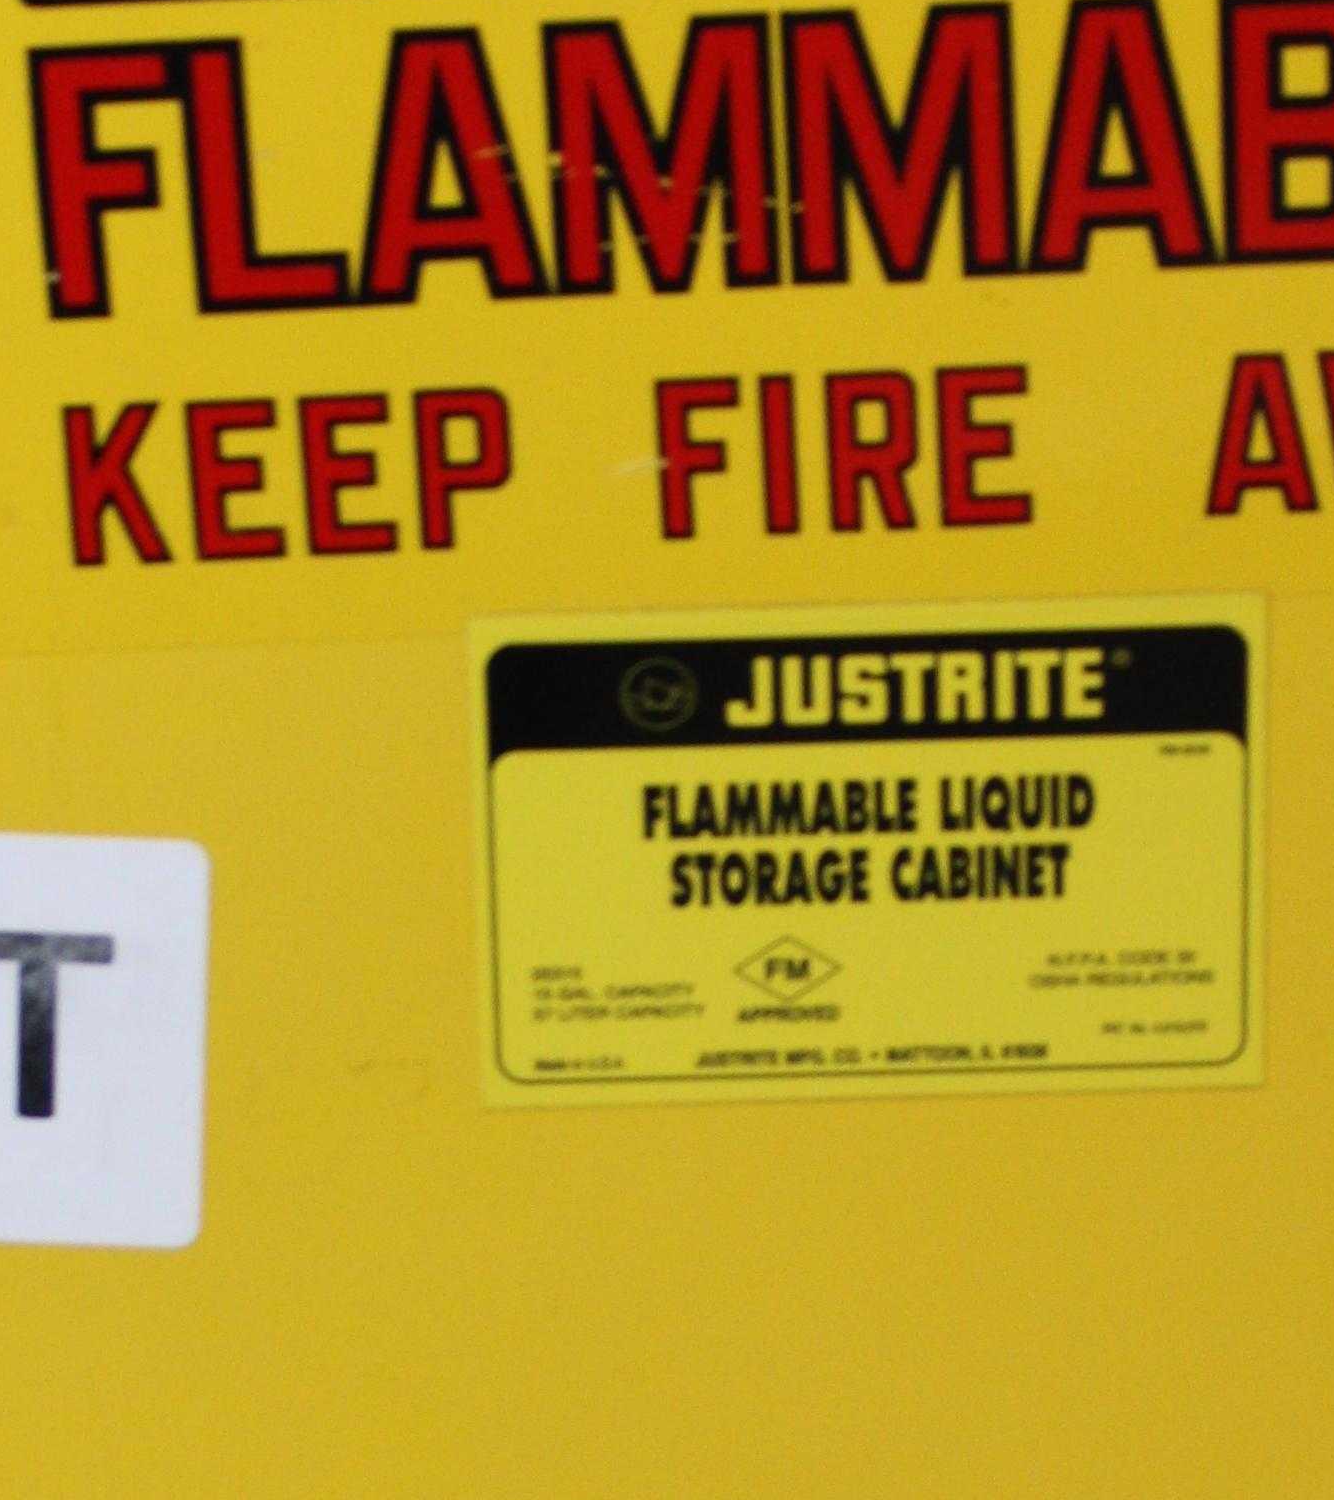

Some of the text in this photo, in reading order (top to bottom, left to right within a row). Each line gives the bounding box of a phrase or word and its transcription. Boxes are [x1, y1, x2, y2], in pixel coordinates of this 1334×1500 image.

[61, 387, 515, 567] KEEP
[653, 363, 1035, 540] FIRE
[724, 647, 1106, 729] JUSTRITE
[642, 773, 1096, 840] FLAMMABLE LIQUID
[671, 845, 1072, 907] STORAGE CABINET
[764, 957, 811, 980] FM
[736, 1004, 840, 1024] APPROVED
